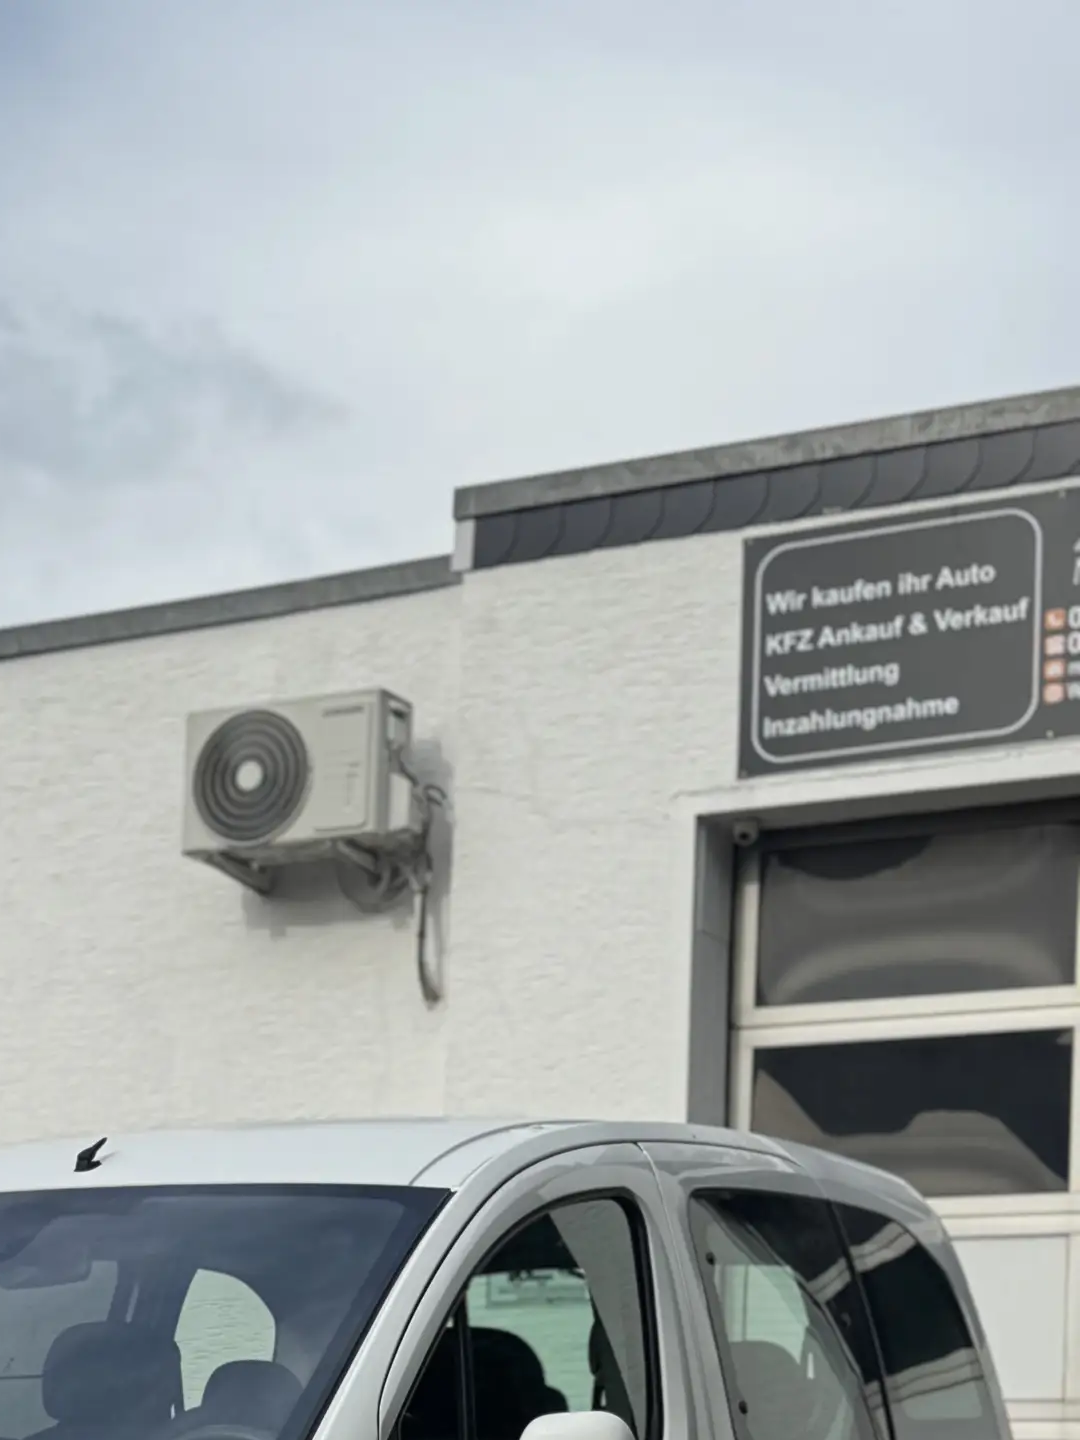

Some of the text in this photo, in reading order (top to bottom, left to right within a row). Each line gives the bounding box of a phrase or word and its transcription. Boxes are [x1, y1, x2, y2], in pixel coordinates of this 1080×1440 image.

[765, 563, 996, 615] Wir kaufen ihr Auto
[765, 596, 1030, 656] KFZ Ankauf & Verkauf
[764, 661, 900, 697] Vermittlung
[763, 695, 960, 739] Inzahlungnahme
